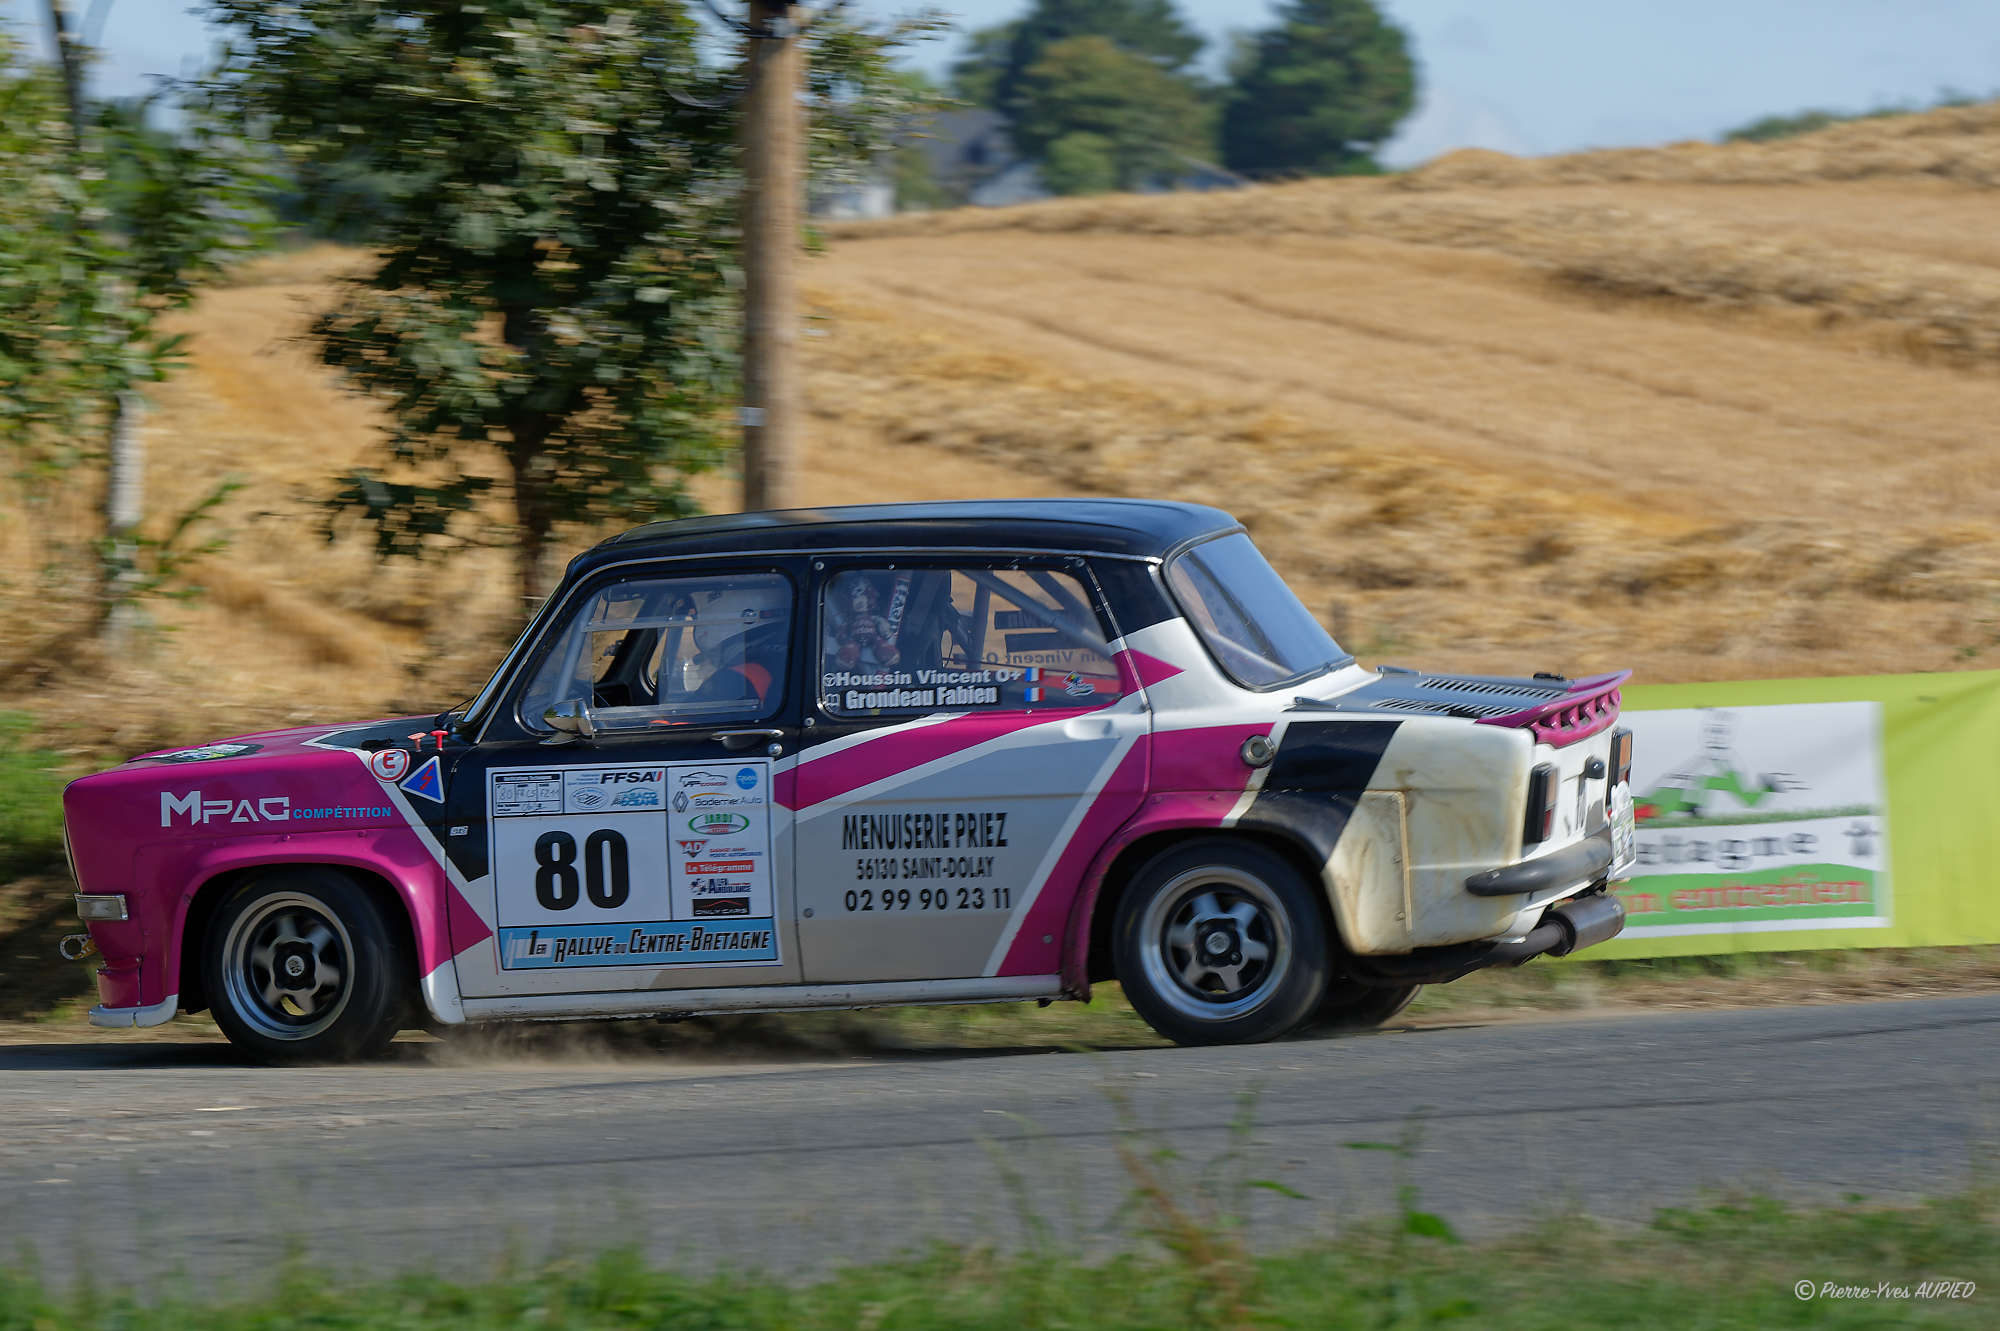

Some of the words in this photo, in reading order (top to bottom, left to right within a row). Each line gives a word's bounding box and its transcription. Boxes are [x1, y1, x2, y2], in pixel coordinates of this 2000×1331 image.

[835, 671, 912, 686] Houssin
[917, 669, 992, 685] Vincent
[846, 688, 934, 709] Grondeau
[937, 686, 998, 706] Fabien
[383, 752, 396, 769] E
[600, 772, 654, 785] FFSA
[293, 805, 392, 819] COMPÉTITION
[843, 814, 949, 849] MENUISERIE
[954, 812, 1008, 848] PRIEZ
[535, 829, 629, 911] 80
[856, 859, 898, 880] 56130
[902, 856, 994, 879] SAINT-DOLAY
[845, 889, 874, 911] 02
[881, 888, 911, 910] 99
[919, 888, 947, 910] 90
[956, 887, 984, 909] 23
[992, 888, 1010, 908] 11
[554, 936, 614, 963] RALLYE
[628, 926, 770, 955] CENTRE-BRETAGNE
